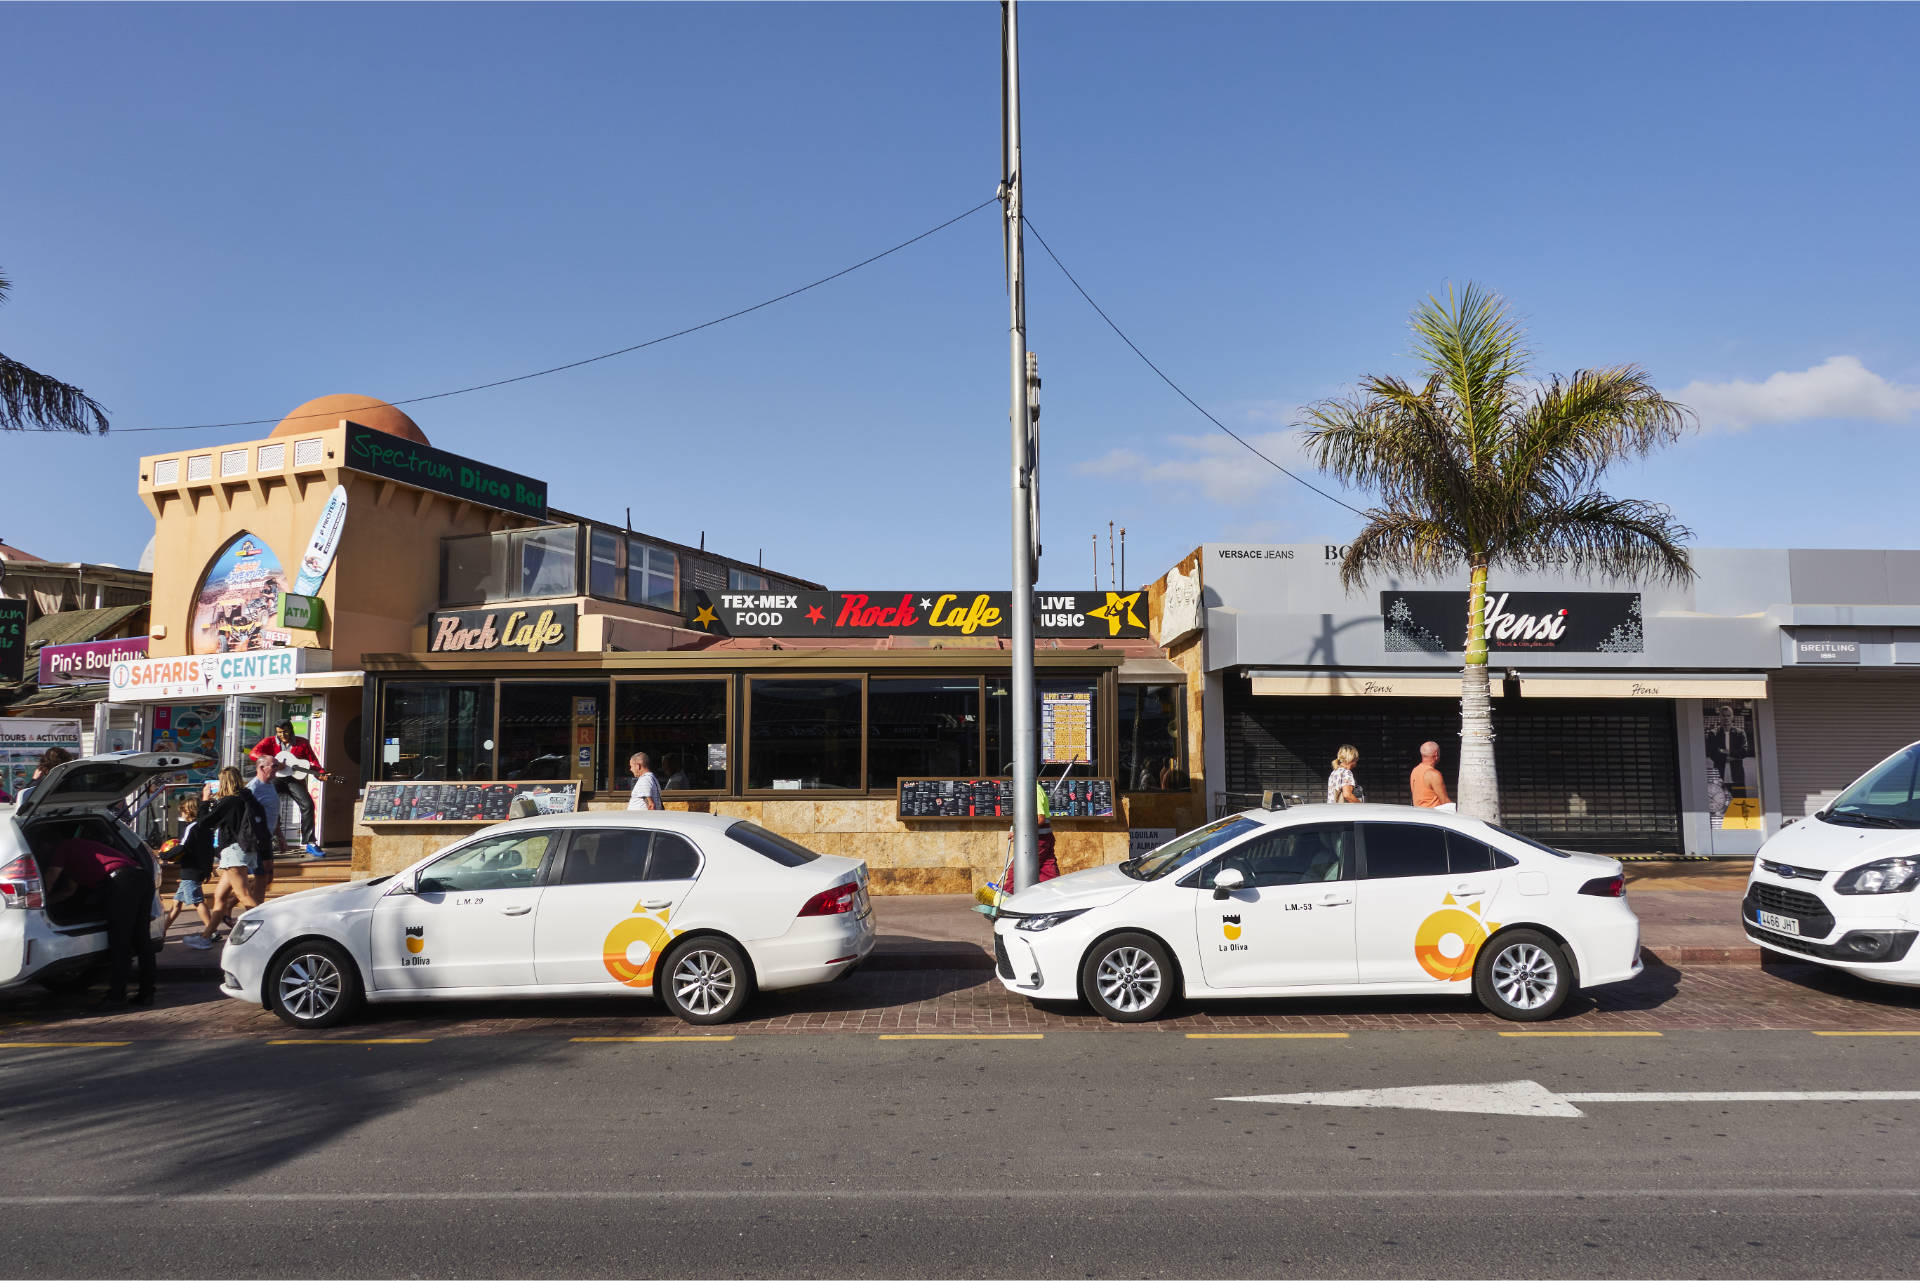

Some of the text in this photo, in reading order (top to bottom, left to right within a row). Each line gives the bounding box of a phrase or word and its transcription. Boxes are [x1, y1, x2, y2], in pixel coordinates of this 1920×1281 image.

[351, 434, 545, 509] Spectrum Disco Bar
[1218, 550, 1295, 560] VERSACE JEANS
[721, 594, 798, 609] TEX-MEX
[1040, 596, 1076, 610] LIVE
[286, 605, 309, 619] ATM
[735, 612, 783, 626] FOOD
[835, 593, 1003, 635] Rock Cafe
[1464, 592, 1568, 646] Hensi
[431, 610, 565, 652] Rock Cafe
[1800, 644, 1856, 652] BREITLING
[50, 651, 83, 673] Pin's
[131, 653, 292, 686] SAFARIS CENTER
[1363, 681, 1393, 695] Hensi
[1631, 683, 1659, 696] Hensi
[288, 703, 307, 713] ATM
[1762, 913, 1796, 932] 4466 JHT
[1218, 943, 1248, 952] La Oliva
[401, 956, 431, 967] La Oliva
